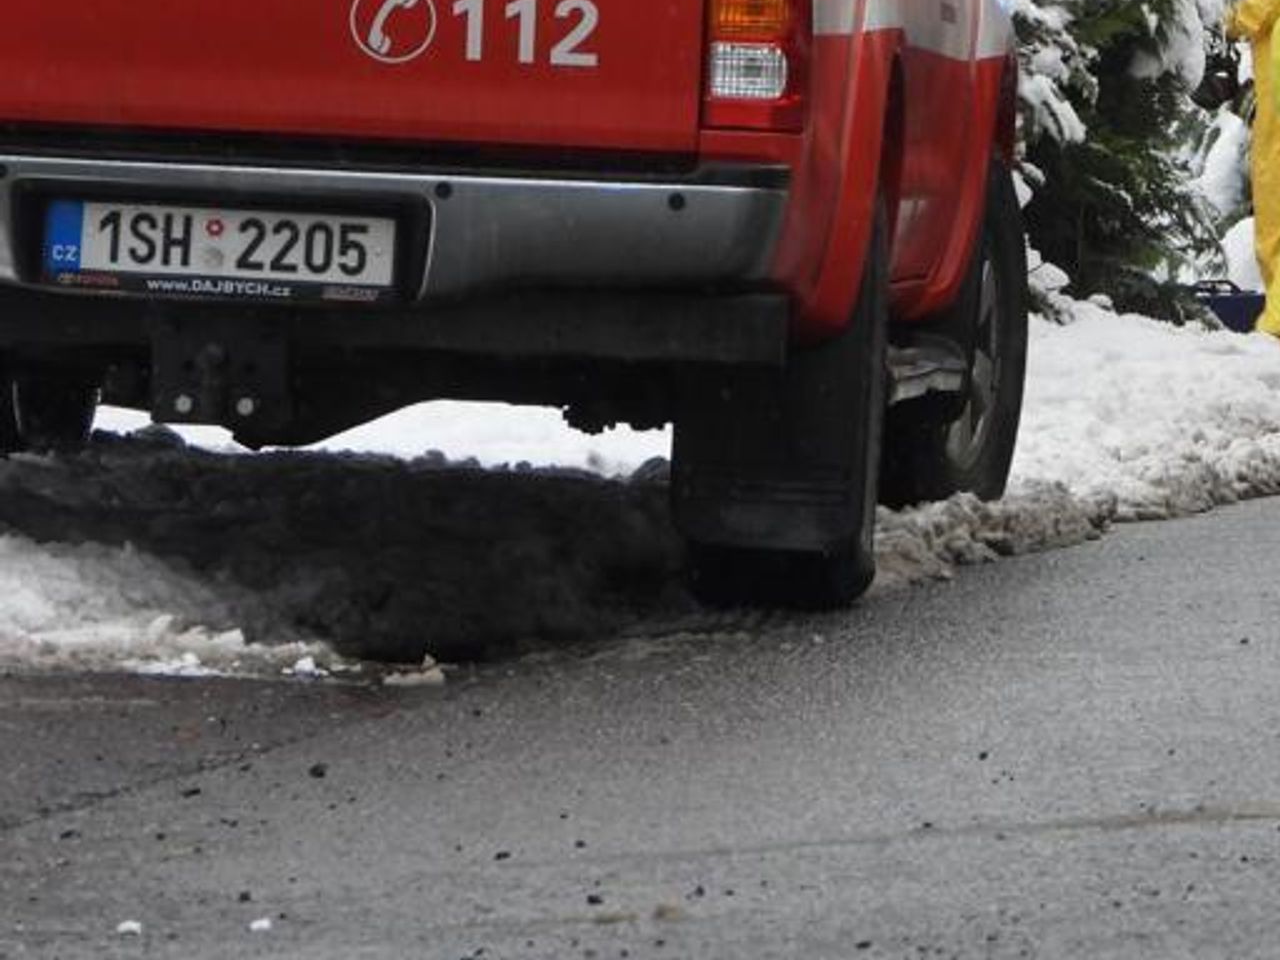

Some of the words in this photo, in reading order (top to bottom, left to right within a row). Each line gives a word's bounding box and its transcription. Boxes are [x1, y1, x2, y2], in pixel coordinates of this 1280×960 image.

[51, 244, 80, 262] CZ
[98, 210, 194, 267] 1SH
[235, 217, 370, 277] 2205
